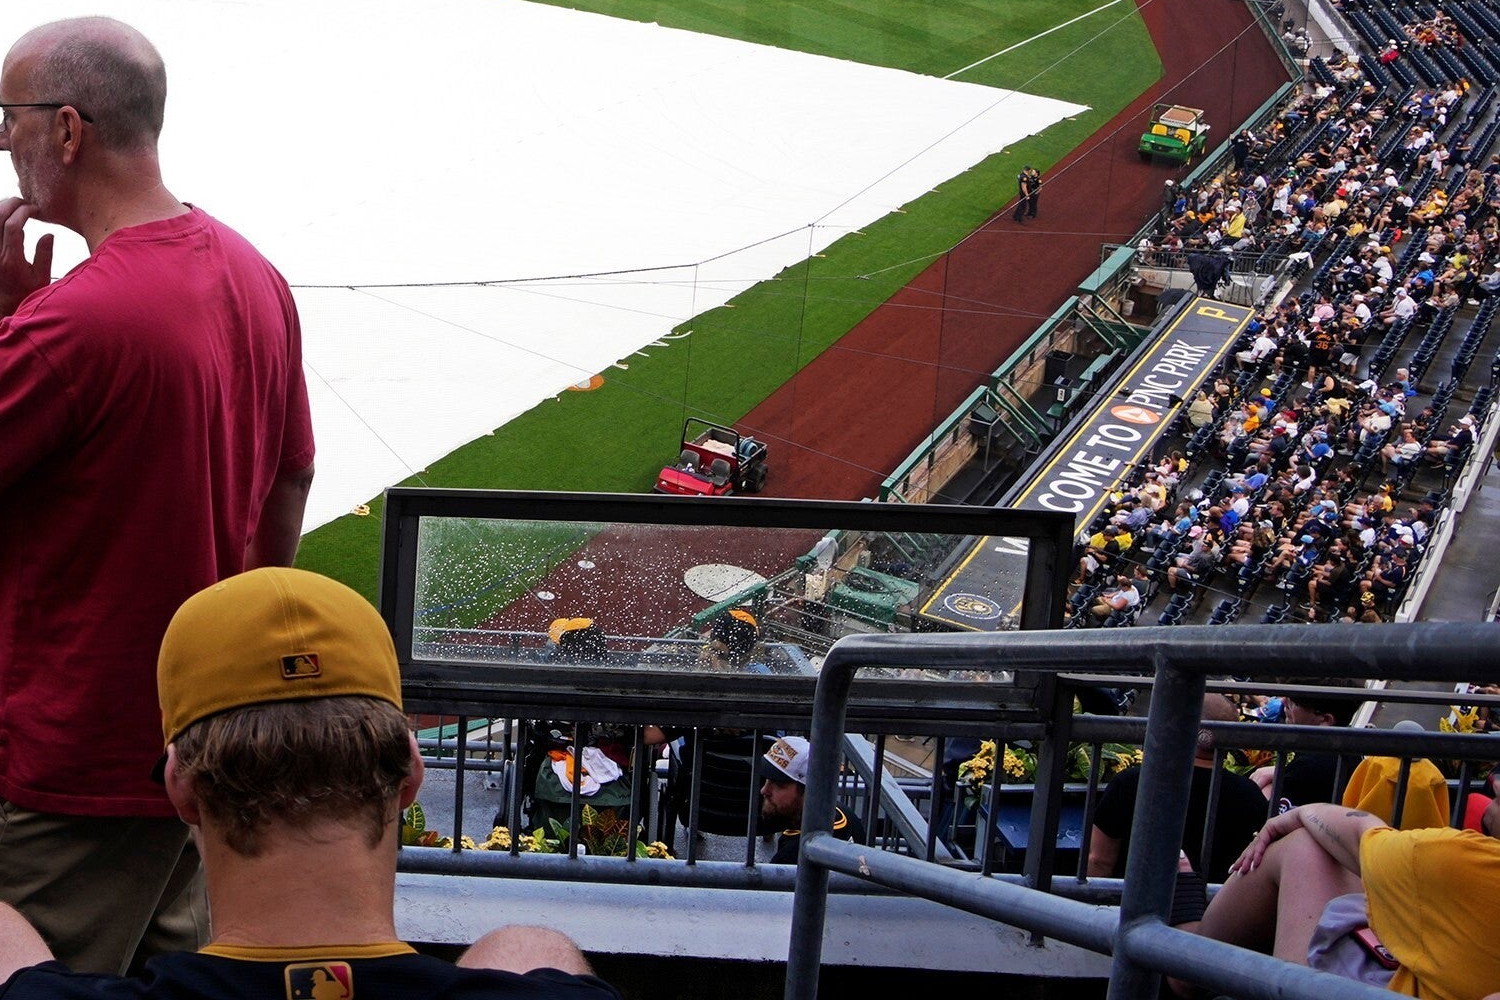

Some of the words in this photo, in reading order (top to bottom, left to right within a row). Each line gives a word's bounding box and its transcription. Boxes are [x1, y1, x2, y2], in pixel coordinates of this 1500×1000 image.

[1087, 424, 1142, 451] TO
[1125, 374, 1181, 410] PNC
[1156, 338, 1212, 379] PARK
